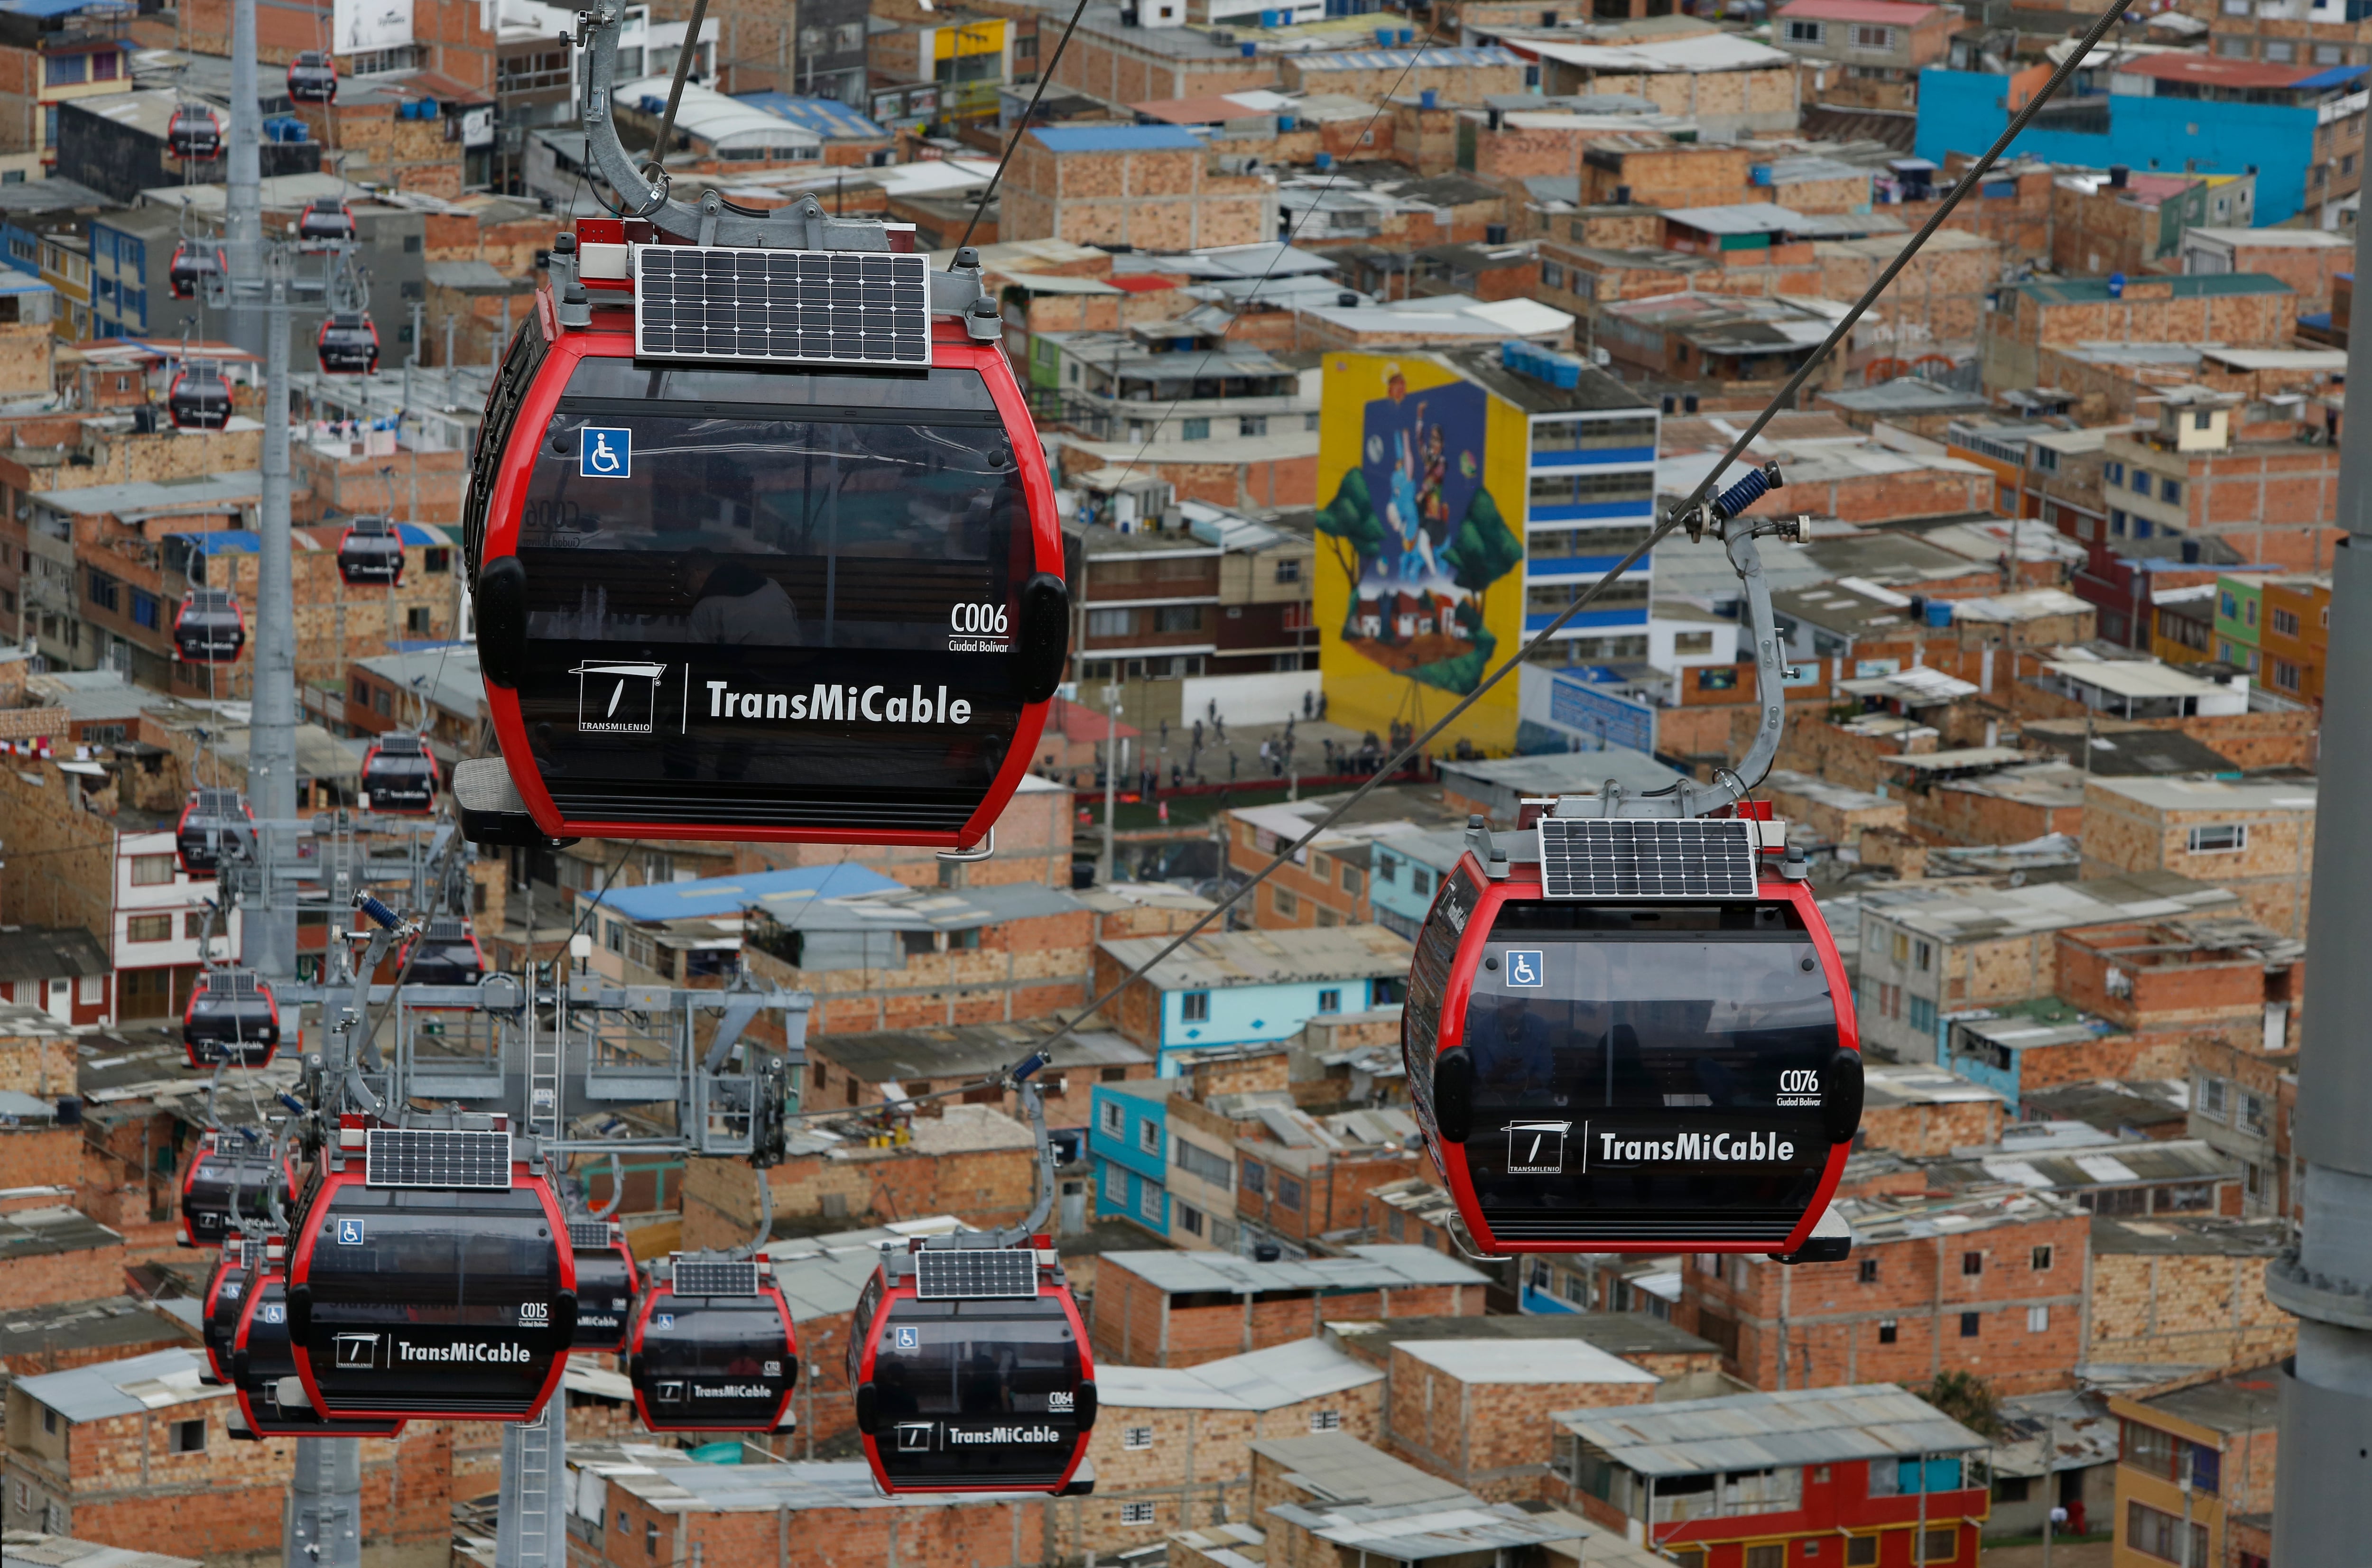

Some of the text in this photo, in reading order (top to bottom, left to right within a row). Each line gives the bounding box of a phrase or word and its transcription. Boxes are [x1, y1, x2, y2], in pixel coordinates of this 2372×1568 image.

[952, 603, 1008, 633] C006
[949, 640, 1009, 653] Ciudad Bolívar
[707, 681, 971, 724] TransMiCable
[582, 722, 650, 731] TRANSMILENIO
[1780, 1070, 1818, 1092] C076
[1777, 1097, 1821, 1106] Ciudad Bolívar
[1601, 1132, 1794, 1161] TransMiCable
[520, 1302, 548, 1318] C015
[399, 1341, 530, 1362] TransMiCable
[694, 1384, 772, 1398] TransMiCable
[1049, 1392, 1074, 1405] C064
[949, 1425, 1059, 1443] TransMiCable
